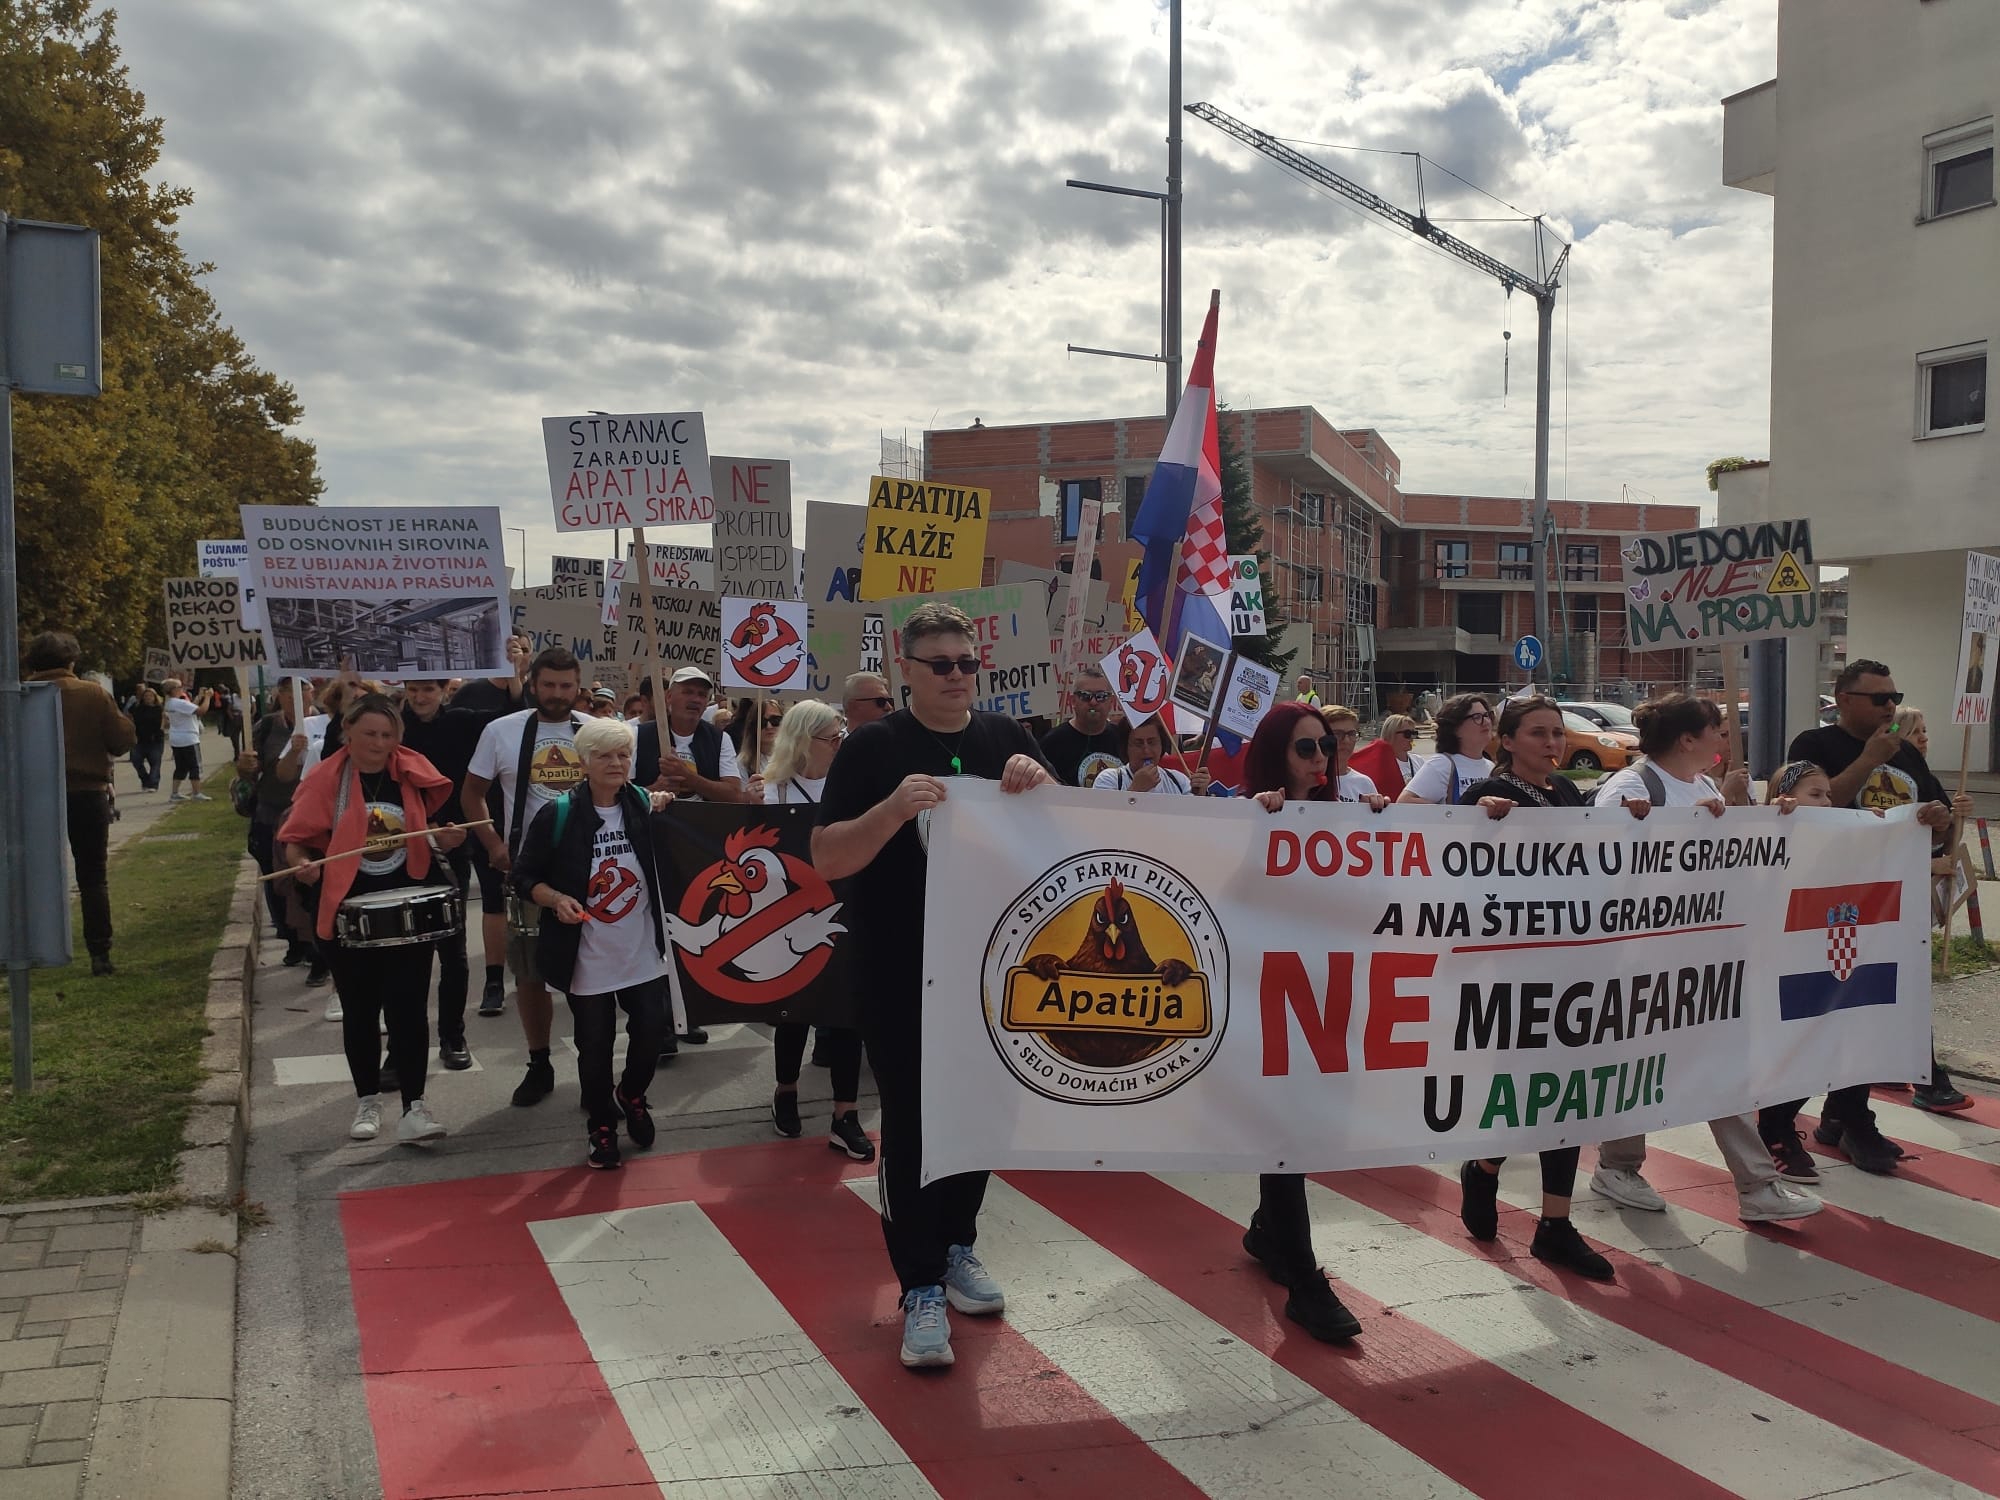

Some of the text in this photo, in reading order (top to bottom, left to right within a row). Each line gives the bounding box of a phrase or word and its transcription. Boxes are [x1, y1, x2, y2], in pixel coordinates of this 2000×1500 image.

[569, 419, 689, 446] STRANAC
[573, 449, 681, 468] ZARAĐUJE
[566, 467, 692, 500] APATIJA
[732, 465, 772, 503] NE
[562, 496, 715, 526] GUTA SMRAD
[871, 480, 982, 523] APATIJA
[262, 515, 479, 532] BUDUĆNOST JE HRANA
[714, 511, 790, 538] PROFITU
[257, 537, 489, 552] OD OSNOVNIH SIROVINA
[874, 523, 955, 559] KAŽE
[264, 554, 488, 572] BEZ UBIJANJA ŽIVOTINJA
[584, 561, 603, 576] JE
[654, 562, 690, 580] NAS
[719, 545, 787, 572] ISPRED
[167, 580, 238, 598] NAROD
[262, 572, 495, 591] I UNIŠTAVANJA PRAŠUMA
[897, 565, 937, 594] NE
[1673, 559, 1772, 602] NIJE
[169, 600, 235, 617] REKAO
[1630, 593, 1816, 645] NA PRODAJU
[171, 641, 235, 664] VOLJU
[239, 639, 268, 661] NA
[990, 663, 1050, 694] PROFIT
[539, 769, 580, 779] Apatija
[1266, 831, 1791, 877] DOSTA ODLUKA U IME GRAĐANA,
[1018, 862, 1202, 926] STOP FARMI PILIĆA
[1373, 890, 1724, 937] A NA ŠTETU GRAĐANA!
[1036, 982, 1183, 1026] Apatija
[1260, 951, 1744, 1076] NE MEGAFARMI
[1019, 1046, 1191, 1093] SELO DOMAĆIH KOKA
[1423, 1053, 1665, 1132] U APATIJI!
